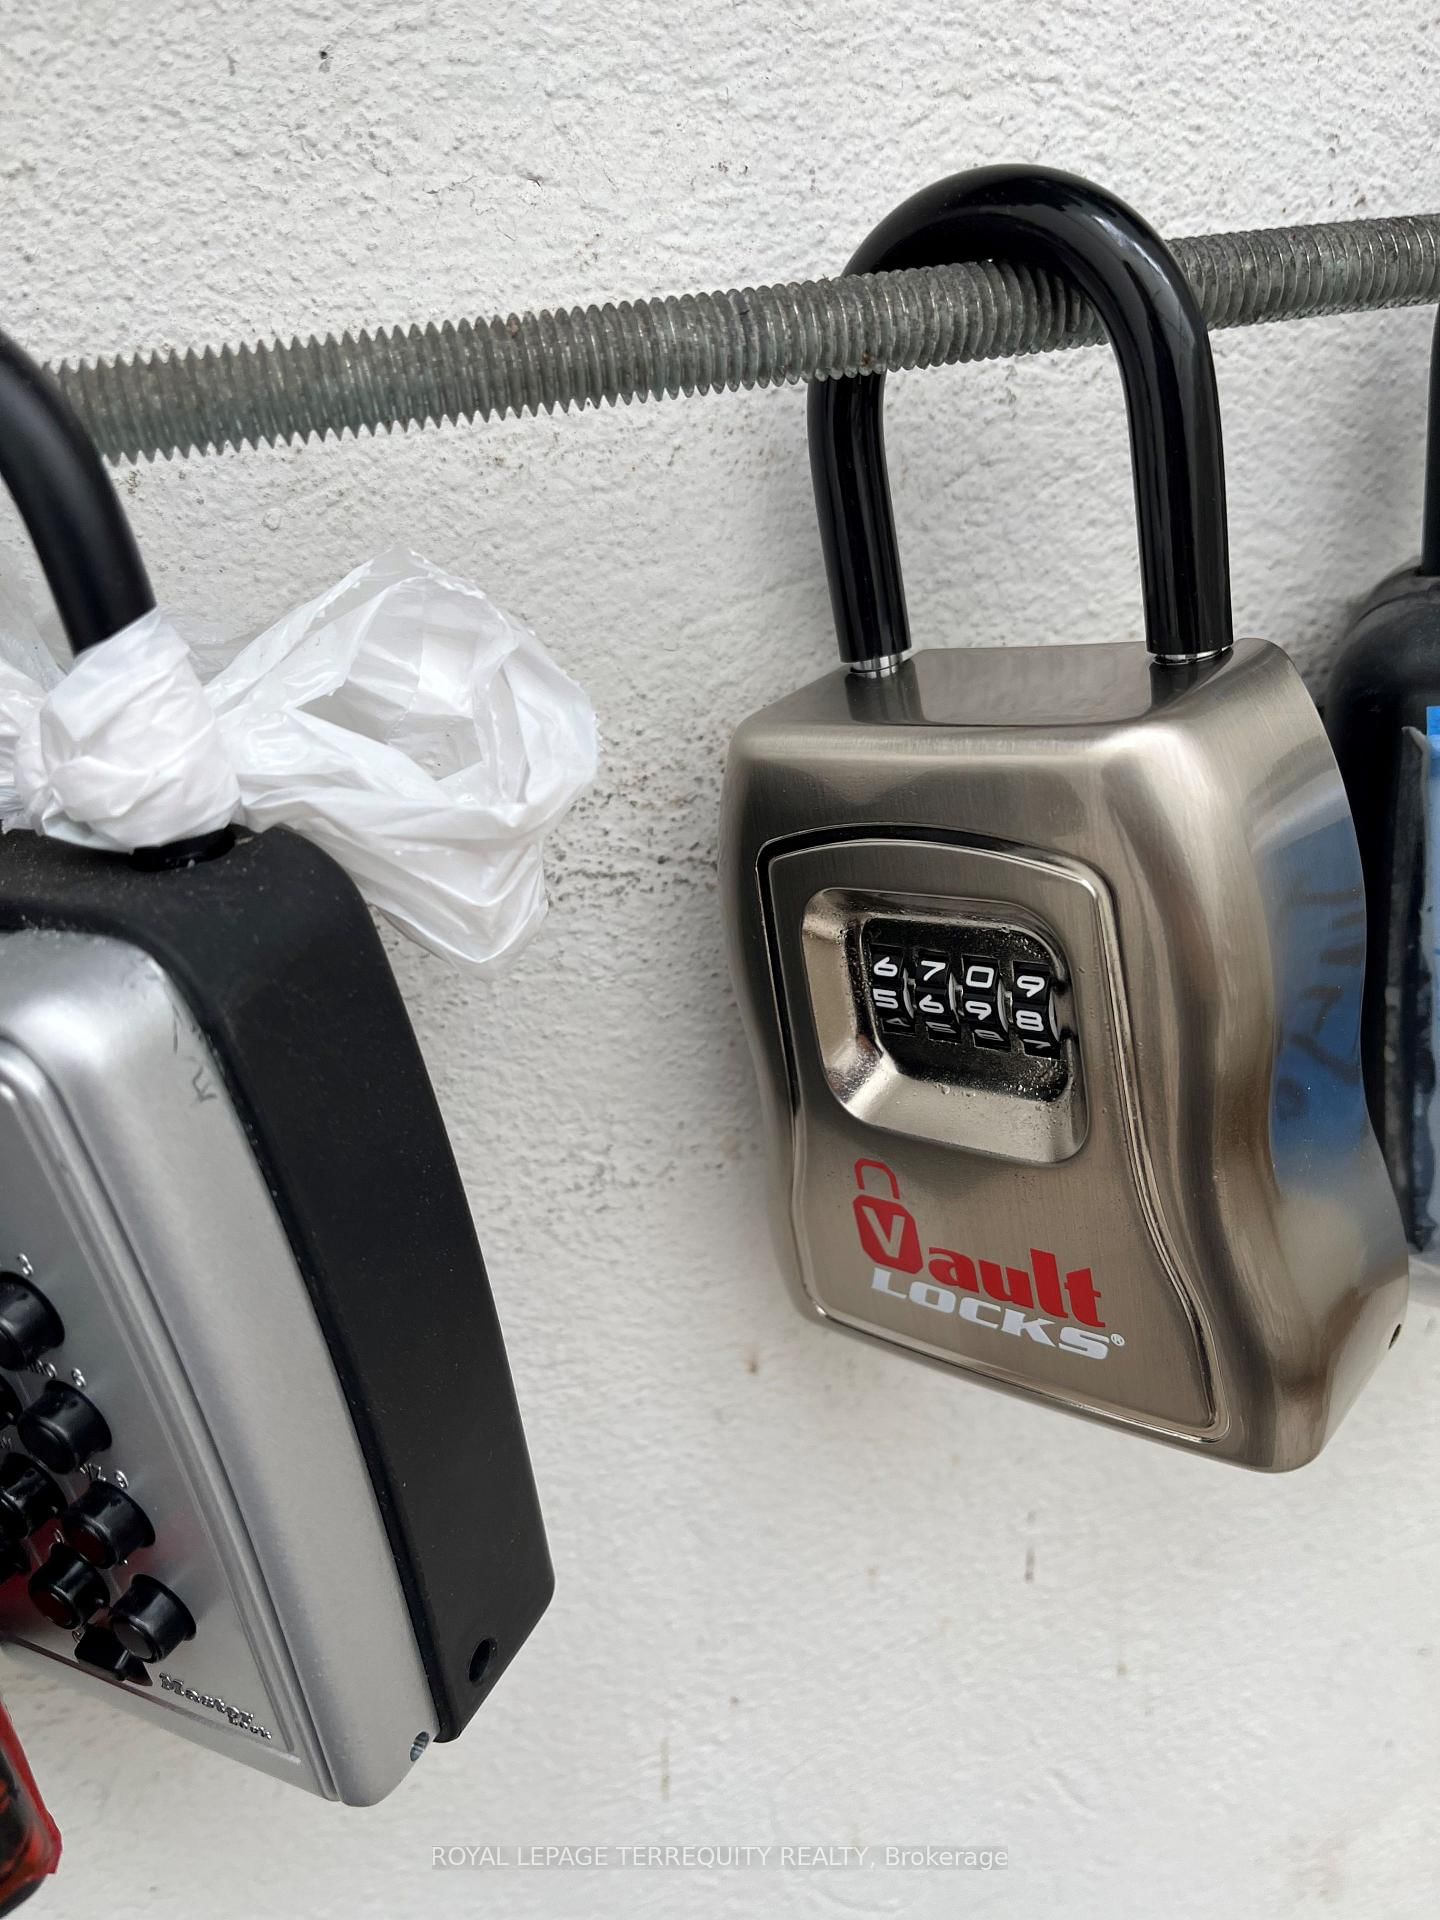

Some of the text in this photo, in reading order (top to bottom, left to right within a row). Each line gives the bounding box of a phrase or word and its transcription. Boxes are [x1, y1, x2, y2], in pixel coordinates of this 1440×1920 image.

[873, 956, 898, 977] 6
[921, 960, 946, 981] 7
[1017, 975, 1045, 998] 9
[873, 988, 1044, 1032] 5 6 9 8
[853, 1194, 1105, 1328] Vault
